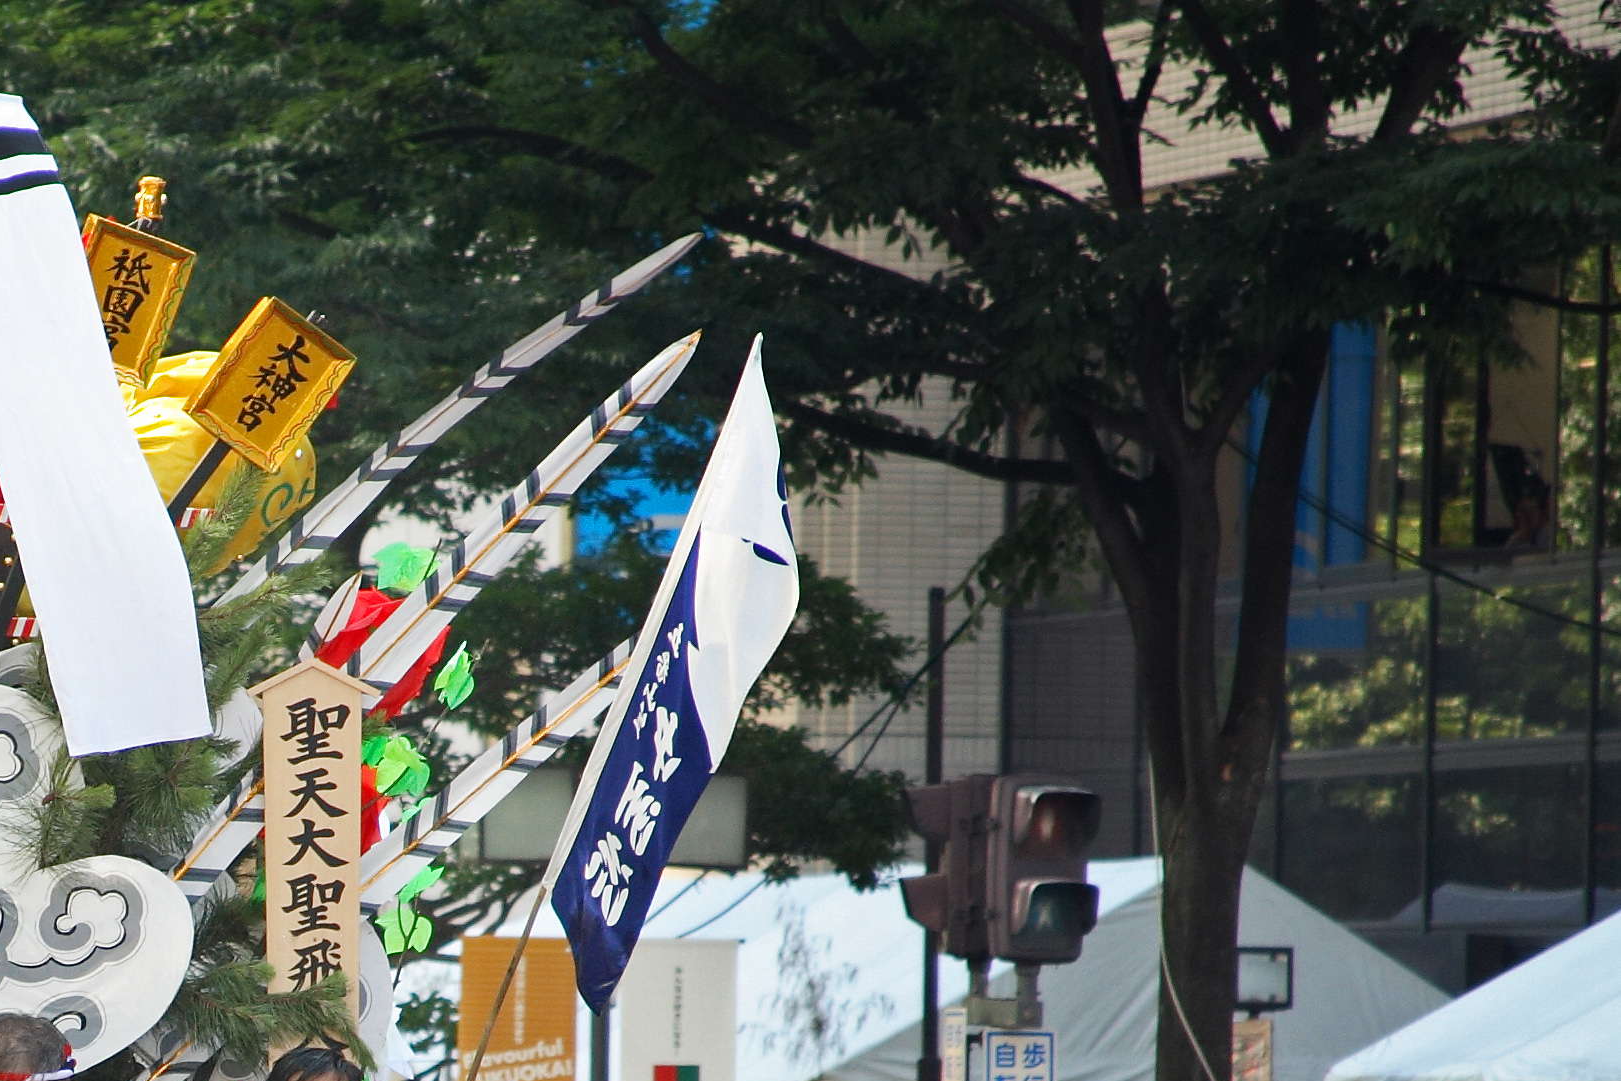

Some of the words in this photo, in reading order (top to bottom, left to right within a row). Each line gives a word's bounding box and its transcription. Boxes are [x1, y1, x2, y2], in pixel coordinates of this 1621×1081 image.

[238, 334, 310, 432] 大神宮
[463, 1038, 564, 1069] Favourful
